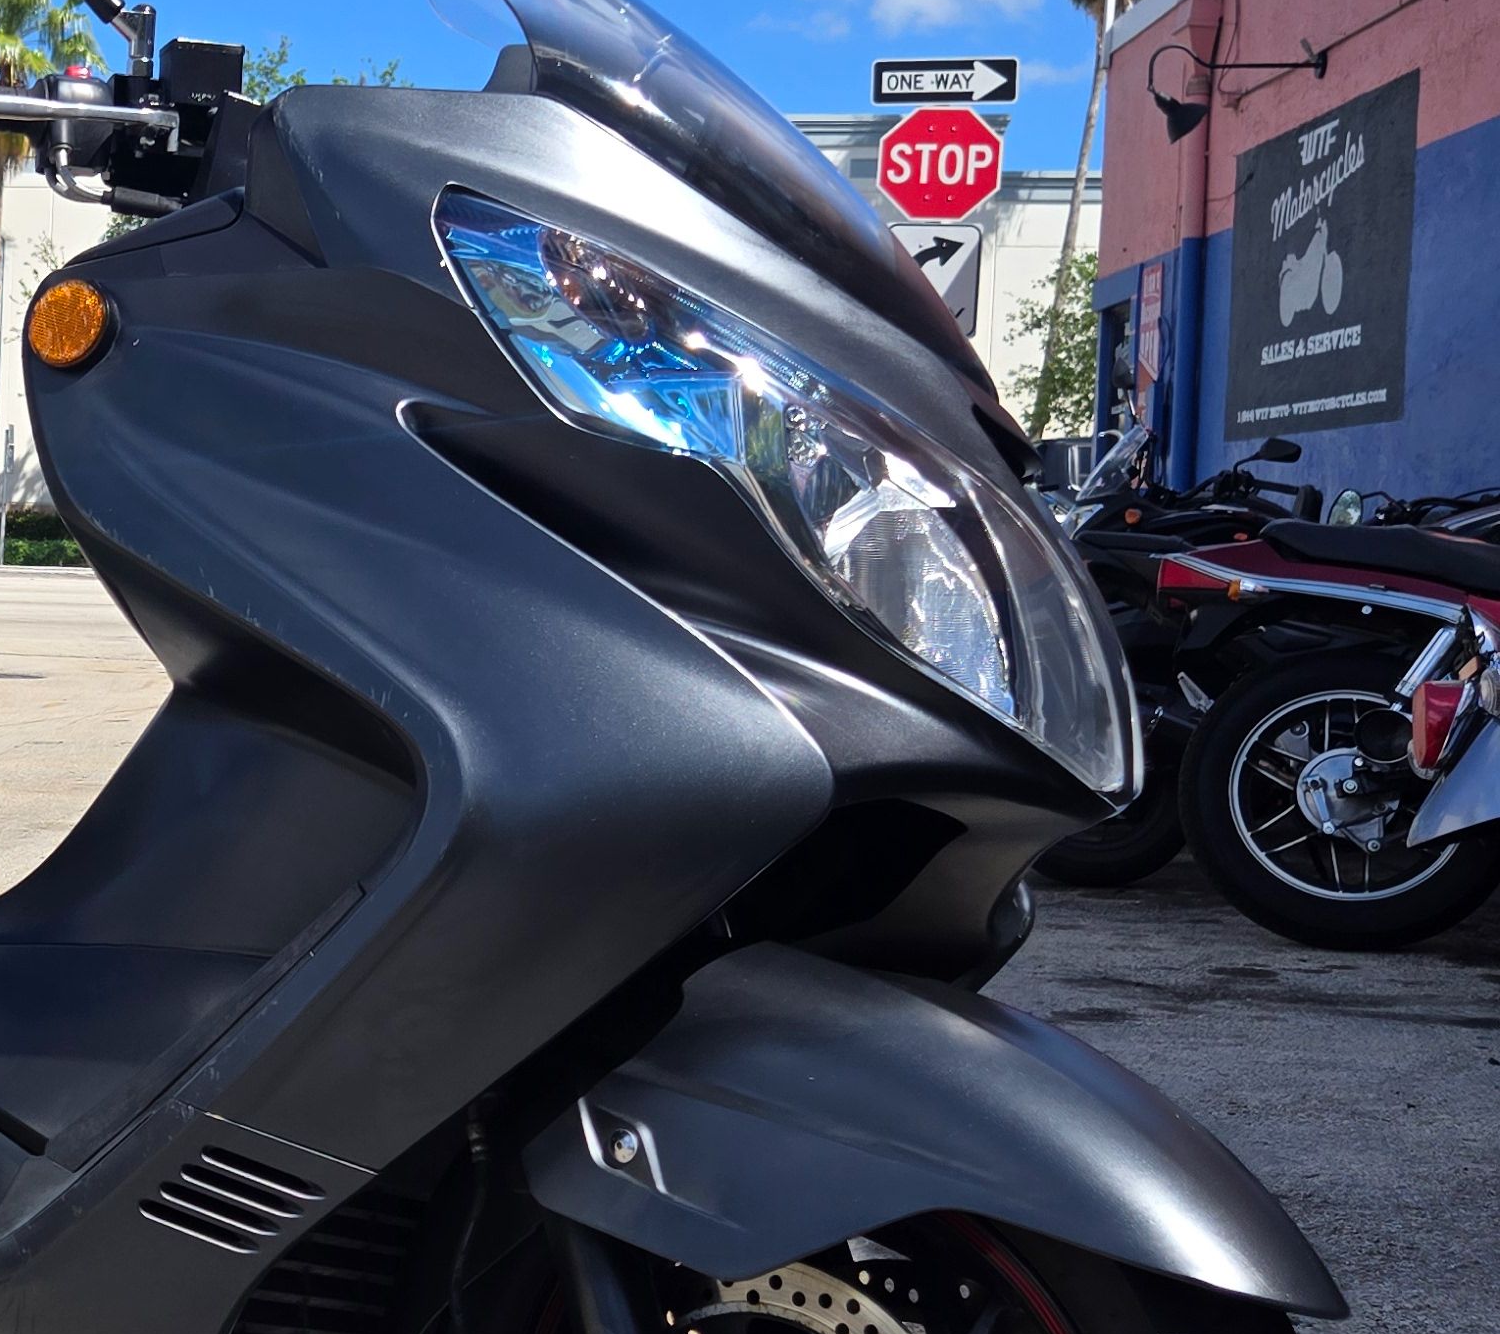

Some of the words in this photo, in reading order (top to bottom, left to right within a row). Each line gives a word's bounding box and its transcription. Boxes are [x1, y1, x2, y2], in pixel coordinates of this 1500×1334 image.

[887, 74, 924, 91] ONE
[934, 73, 974, 90] WAY
[1298, 118, 1340, 166] WTF
[886, 143, 994, 186] STOP
[1270, 131, 1365, 242] Motorcycles
[1261, 340, 1295, 366] SALES
[1295, 338, 1306, 359] &
[1306, 324, 1362, 356] SERVICE
